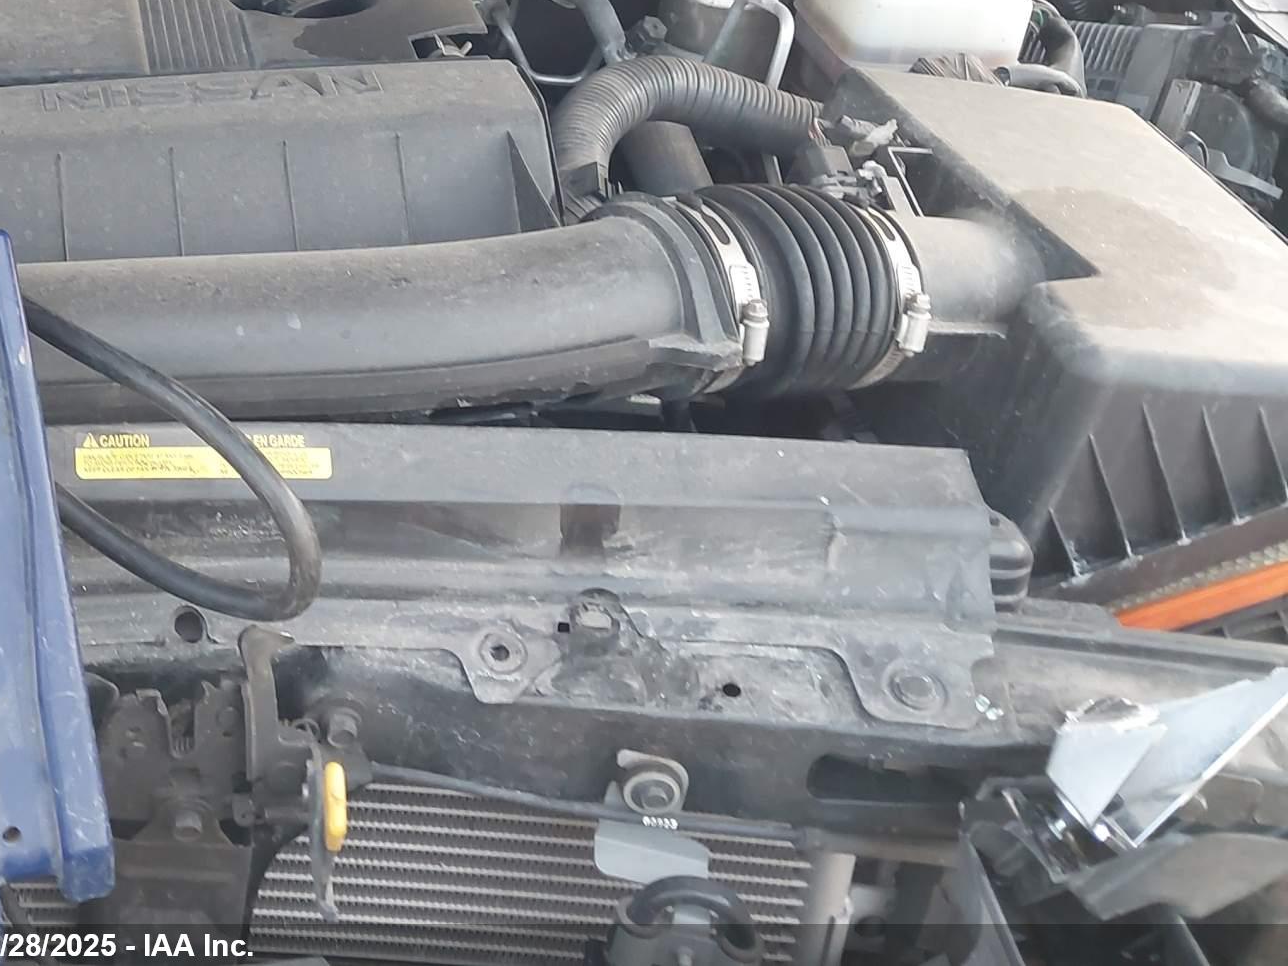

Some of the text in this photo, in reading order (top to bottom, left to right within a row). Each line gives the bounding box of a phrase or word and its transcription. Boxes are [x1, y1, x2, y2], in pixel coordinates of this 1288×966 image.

[40, 70, 385, 113] NISSAN
[99, 434, 150, 447] CAUTION
[269, 434, 305, 447] GARDE
